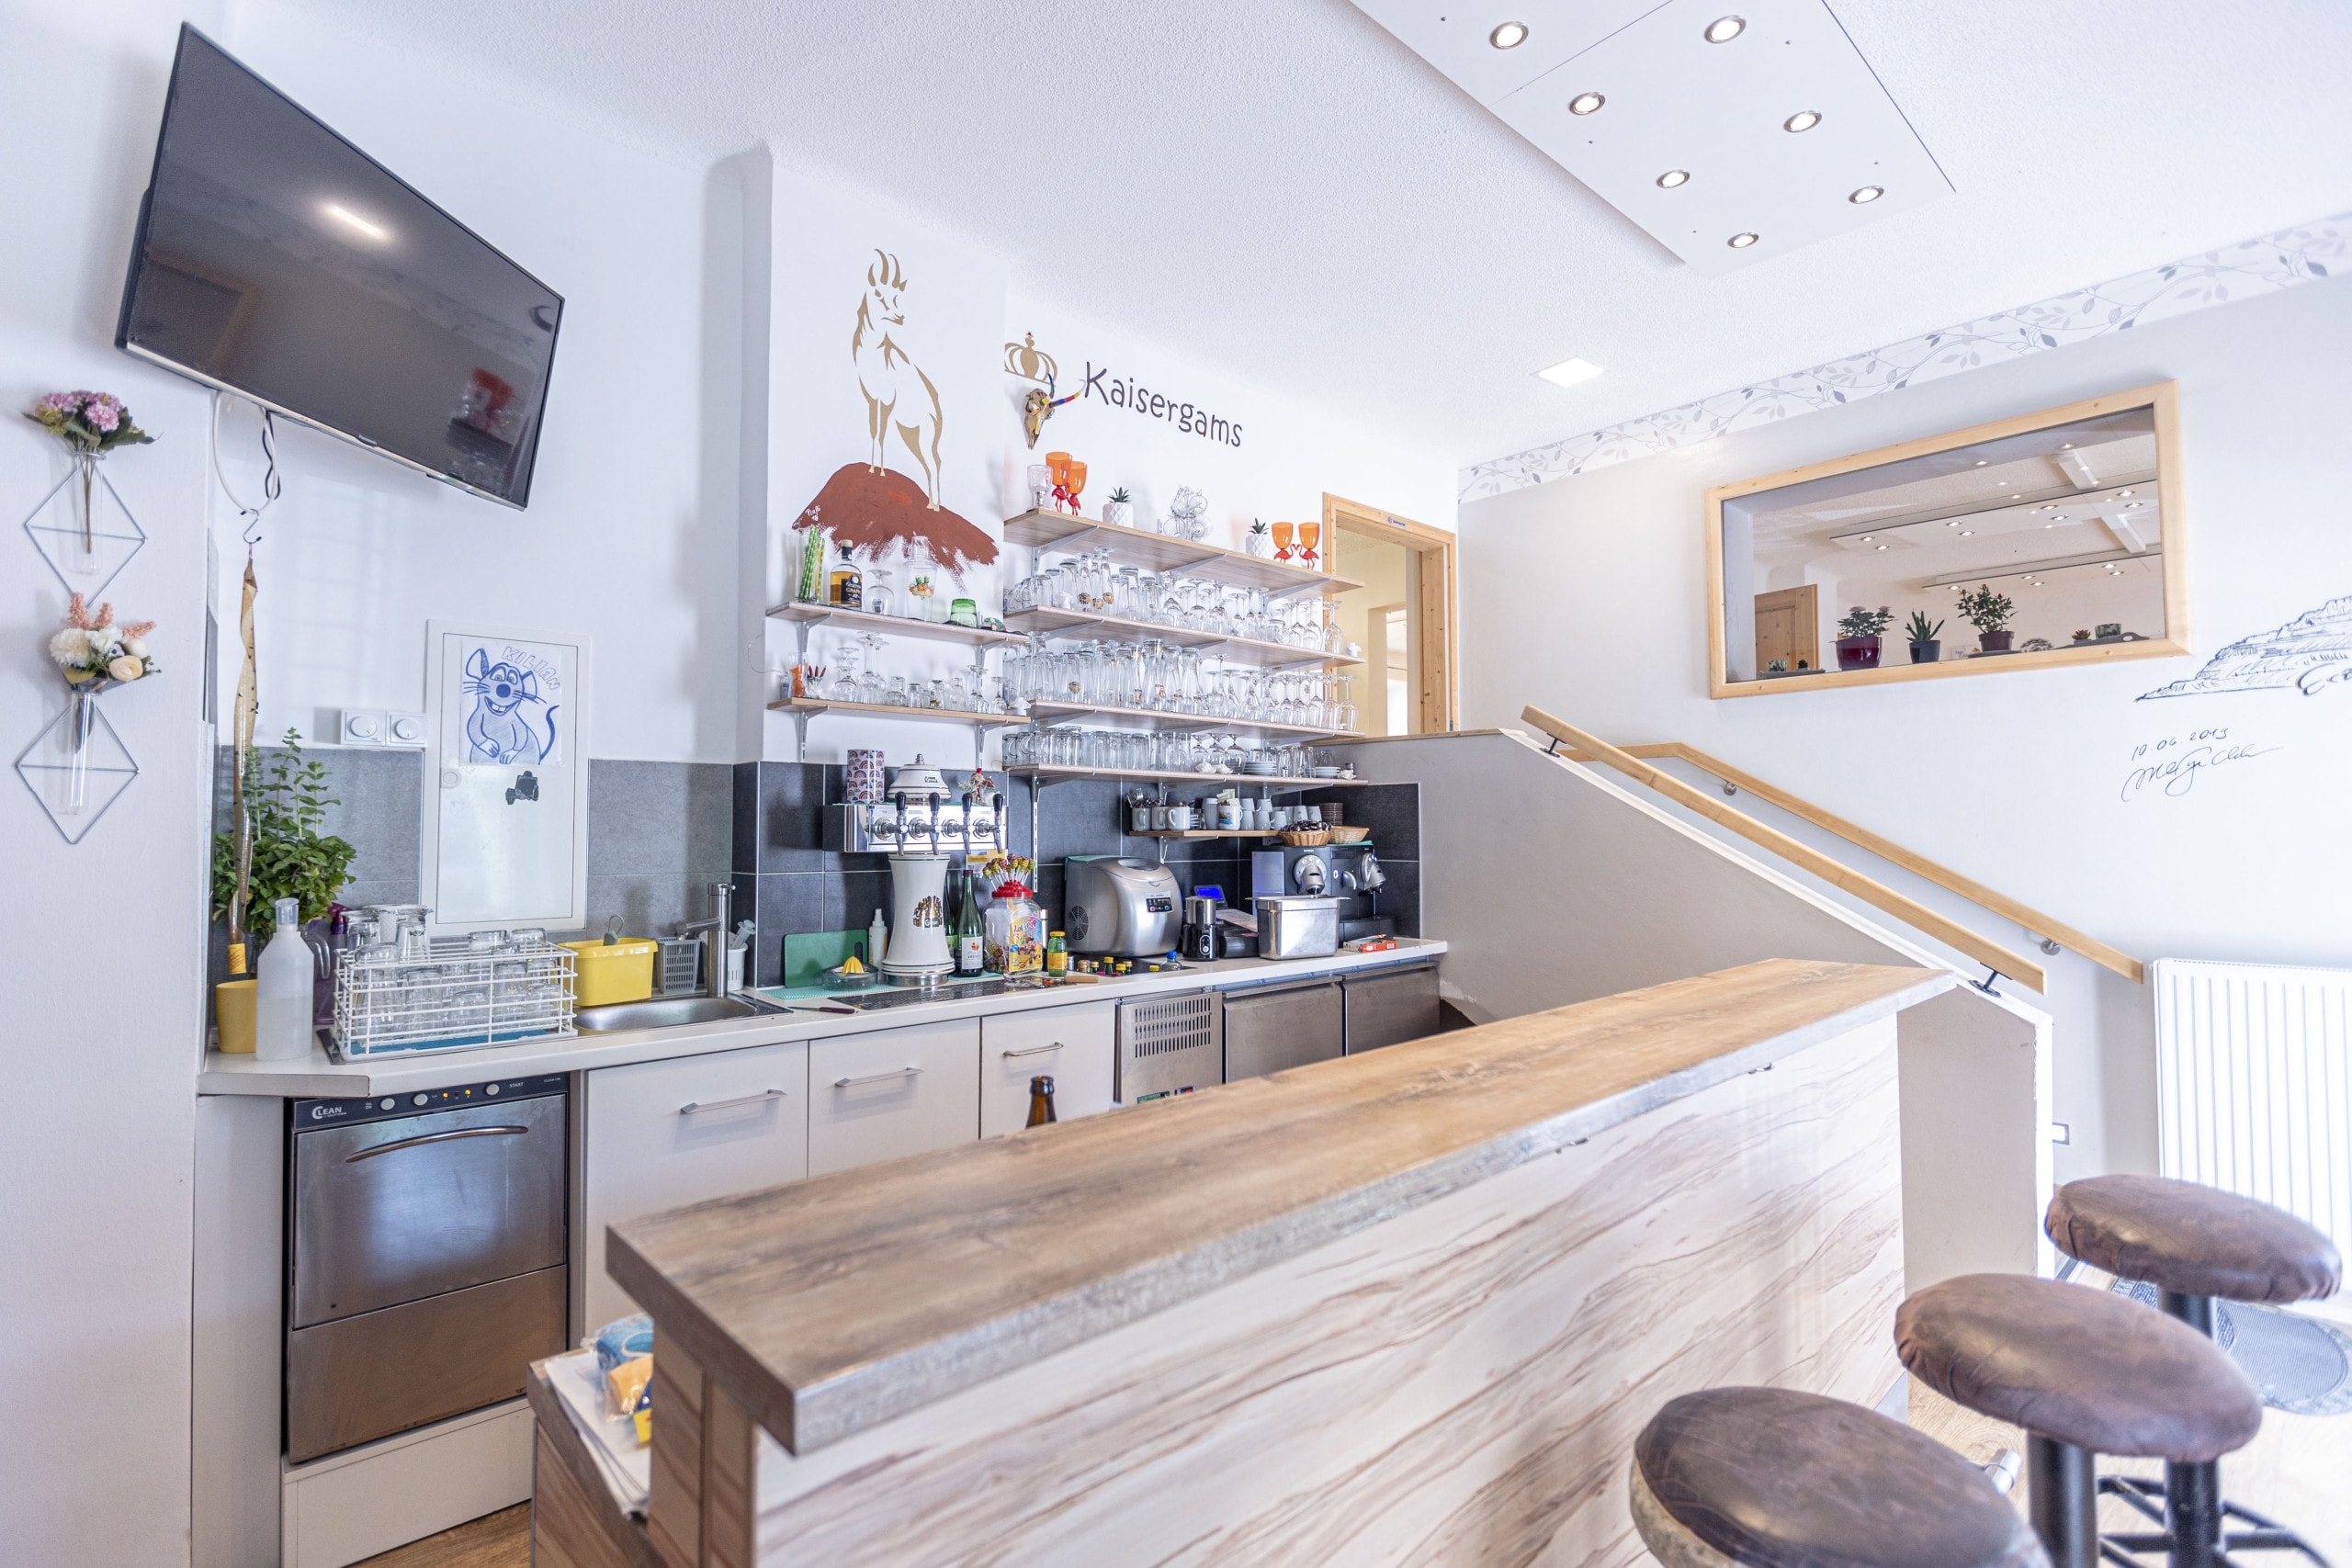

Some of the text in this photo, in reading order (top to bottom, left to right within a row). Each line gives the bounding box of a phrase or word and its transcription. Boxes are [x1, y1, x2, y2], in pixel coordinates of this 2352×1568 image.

[1084, 361, 1243, 447] Kaisergams
[501, 646, 560, 691] KILIAN
[311, 1105, 343, 1120] CLEAN
